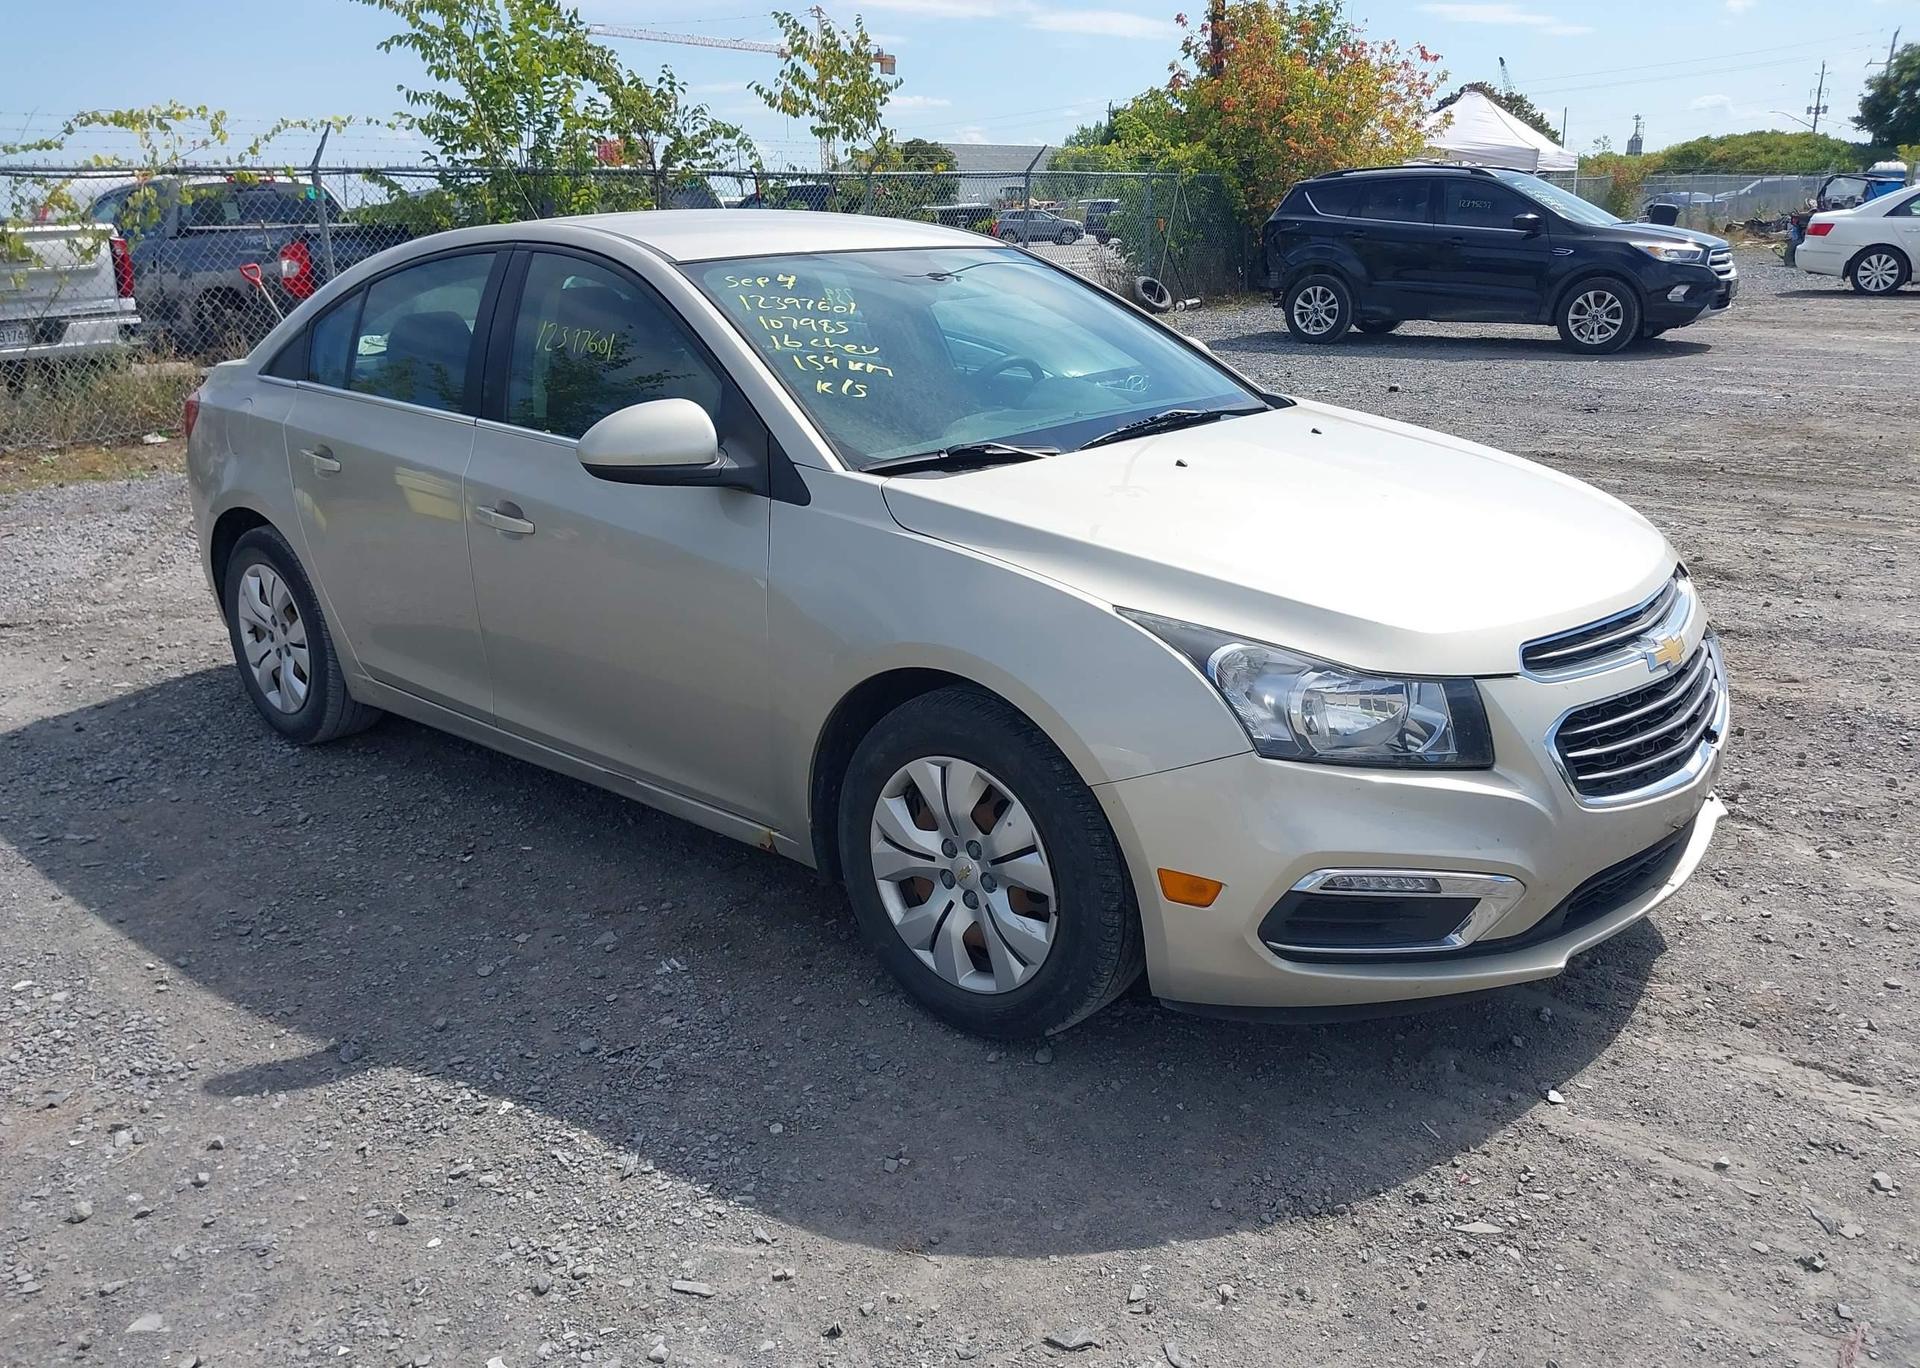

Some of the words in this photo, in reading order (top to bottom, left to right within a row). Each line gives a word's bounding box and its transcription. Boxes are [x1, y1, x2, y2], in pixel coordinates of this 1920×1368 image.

[739, 294, 856, 315] 12397601
[758, 315, 849, 334] 107985
[535, 320, 615, 362] 12397601
